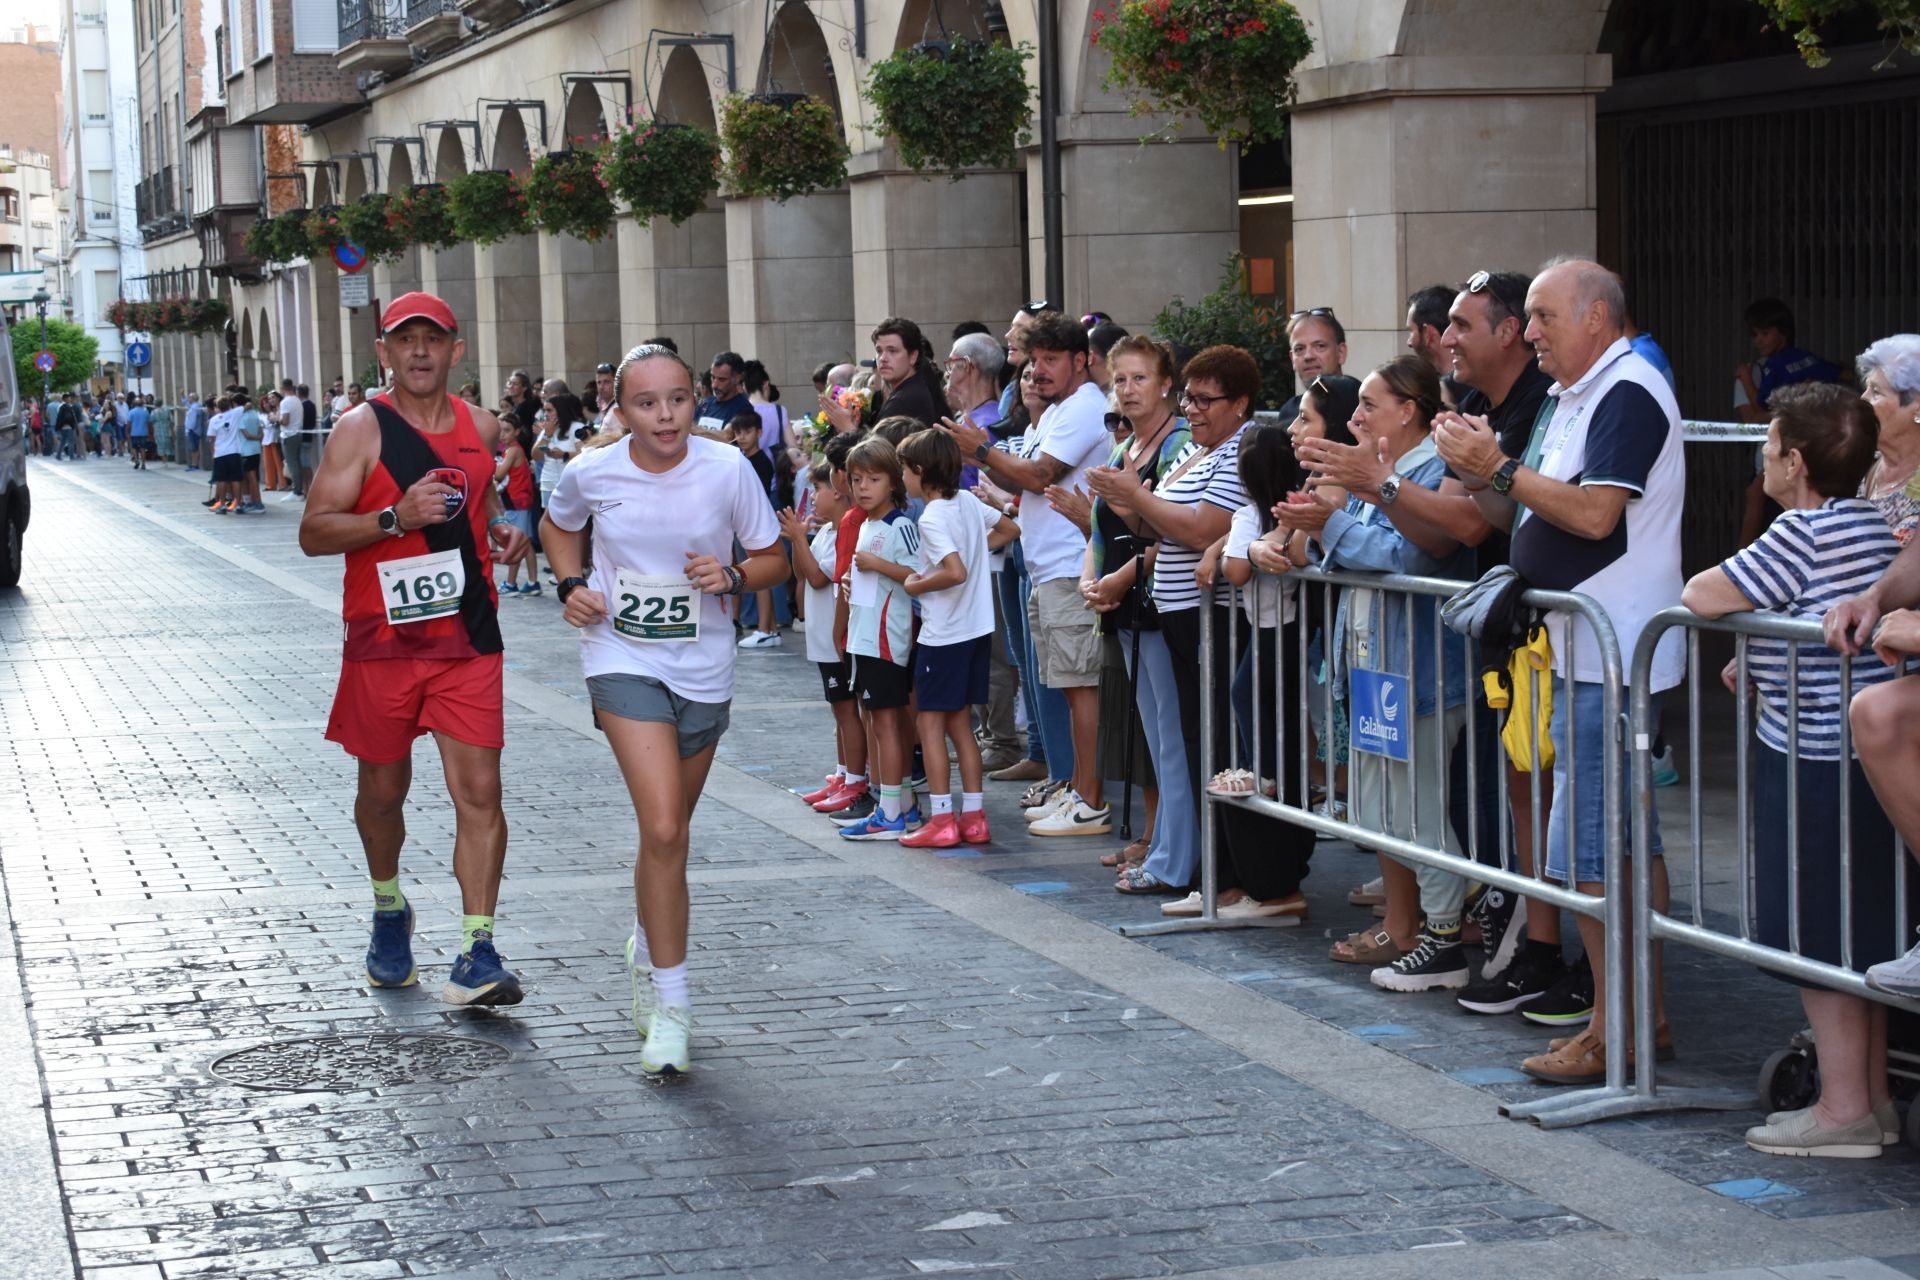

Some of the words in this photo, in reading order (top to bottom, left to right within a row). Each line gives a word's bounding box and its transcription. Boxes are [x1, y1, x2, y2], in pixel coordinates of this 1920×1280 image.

[392, 571, 457, 604] 169
[619, 593, 690, 623] 225
[1359, 716, 1398, 741] Calahorra
